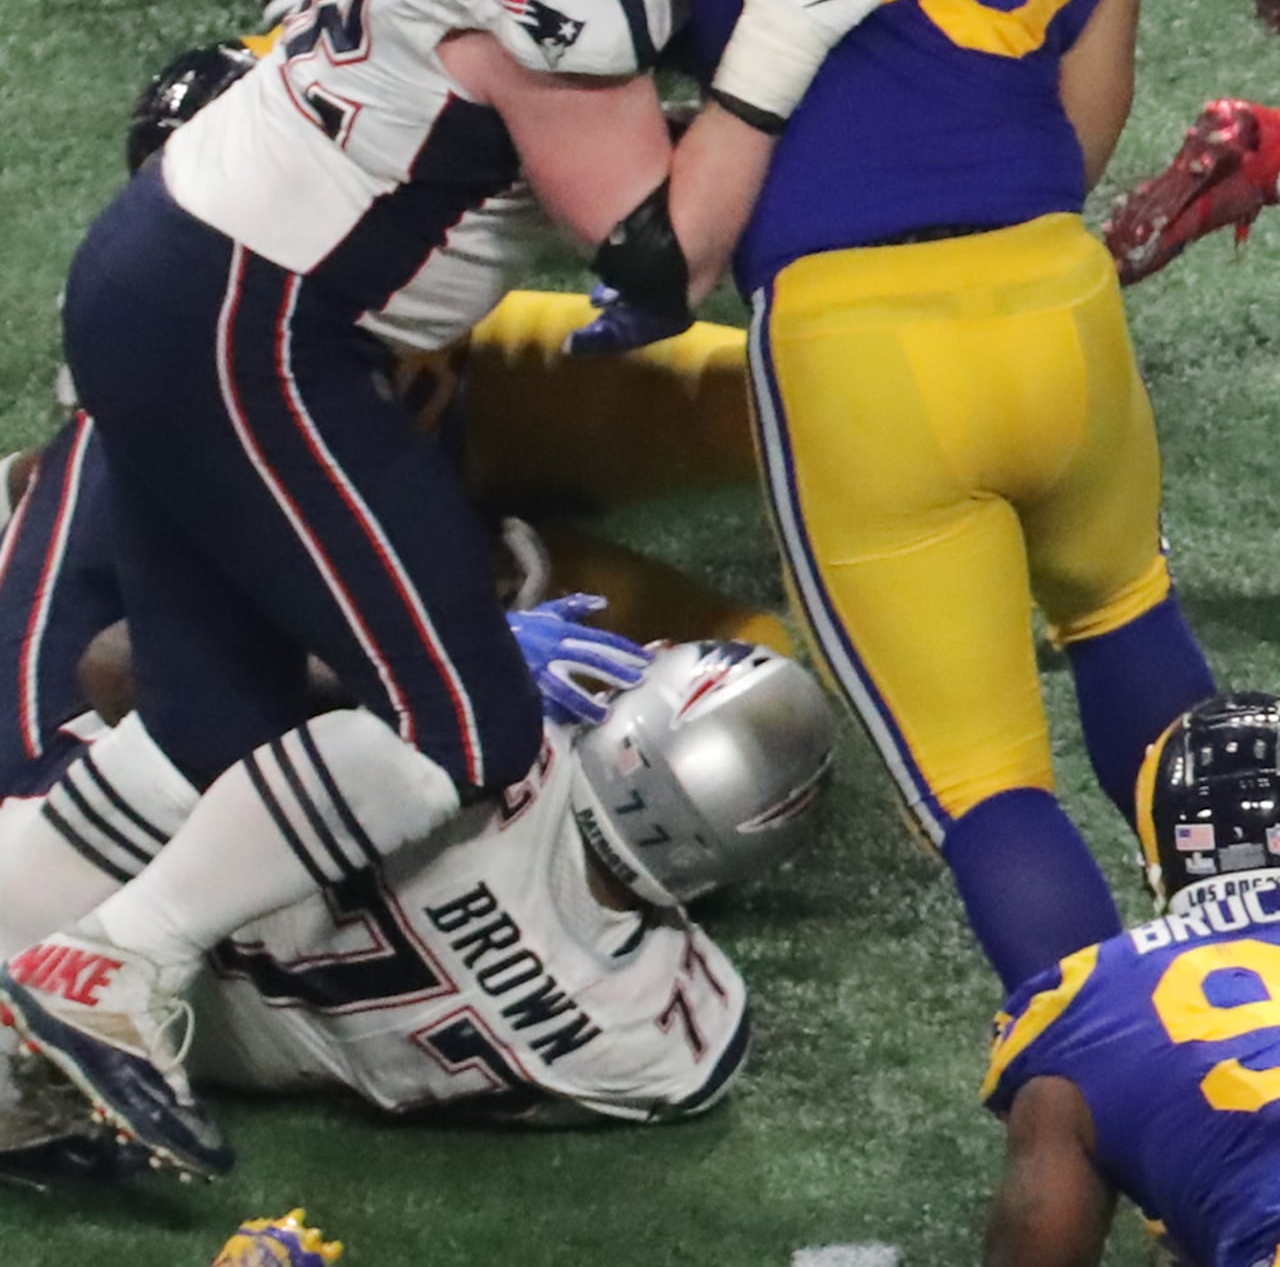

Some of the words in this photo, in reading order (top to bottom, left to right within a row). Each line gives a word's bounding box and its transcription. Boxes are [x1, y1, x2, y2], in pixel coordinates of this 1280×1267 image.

[614, 789, 672, 847] 77
[7, 941, 124, 1008] NIKE
[424, 881, 604, 1068] BROWN
